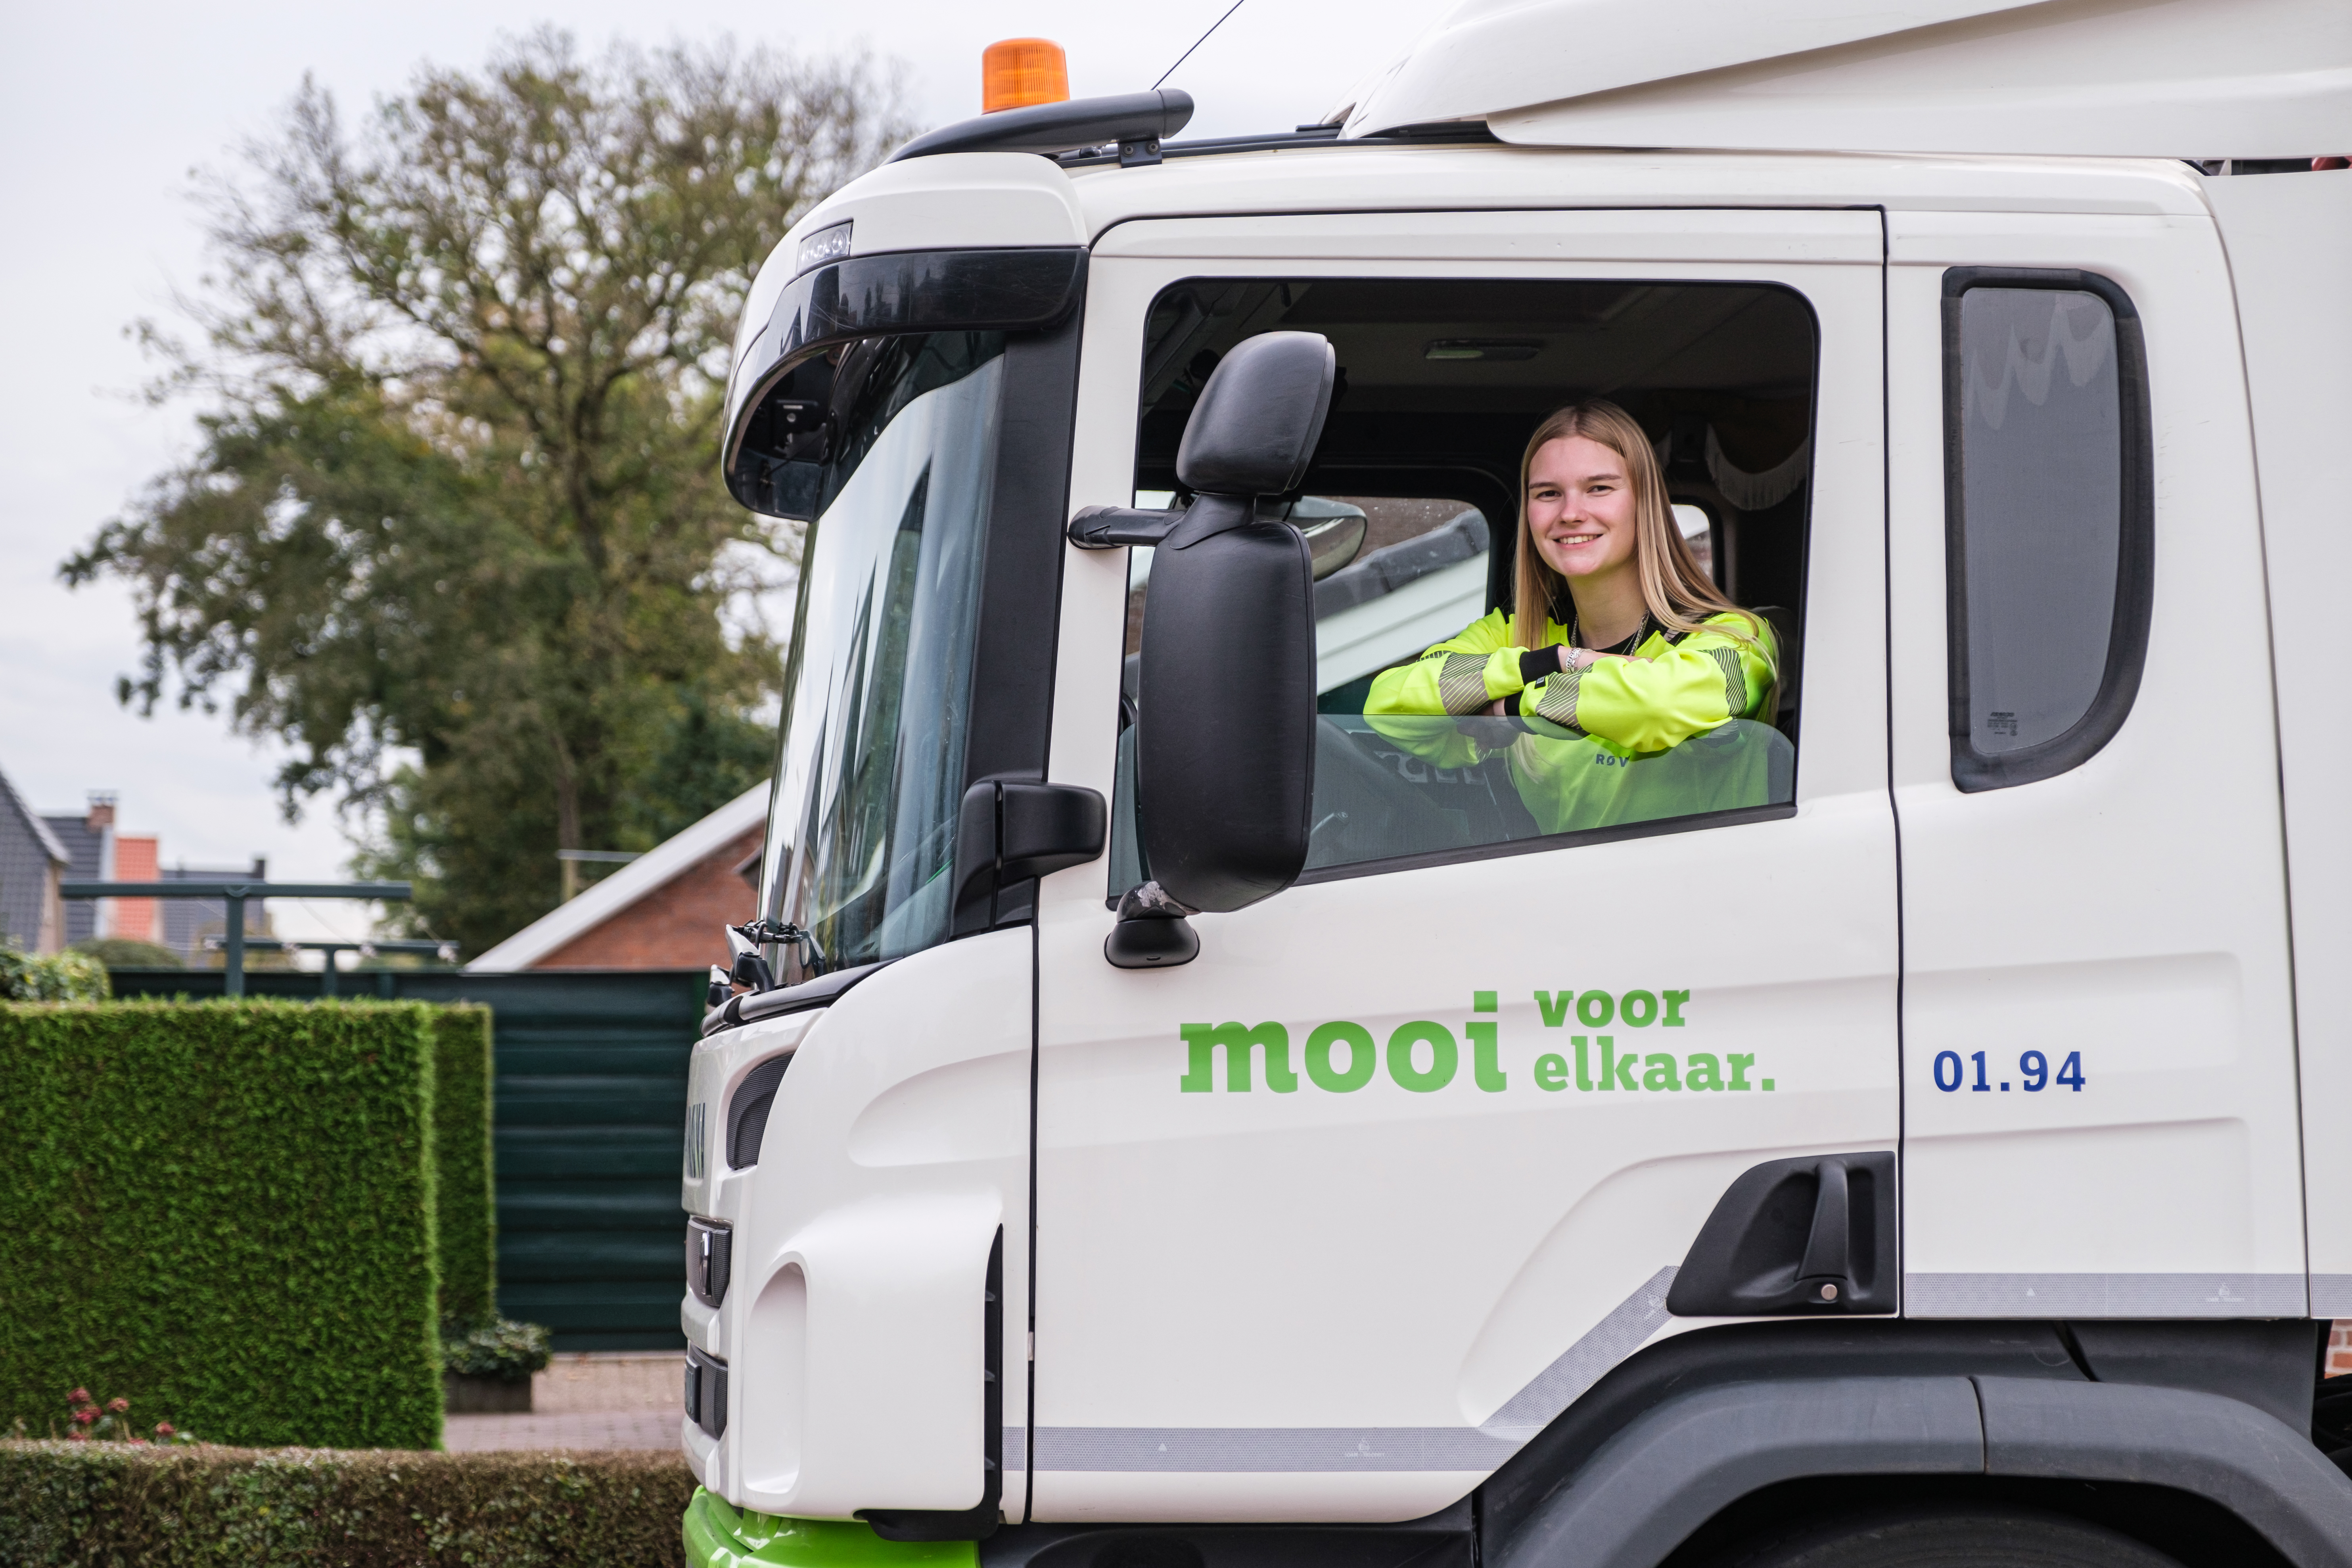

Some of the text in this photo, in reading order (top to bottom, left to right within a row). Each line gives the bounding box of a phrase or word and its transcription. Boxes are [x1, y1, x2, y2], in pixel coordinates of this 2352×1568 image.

[1534, 989, 1690, 1028] voor
[1180, 991, 1507, 1093] mooi
[1533, 1036, 1775, 1092] elkaar.
[1934, 1050, 2086, 1092] 01.94
